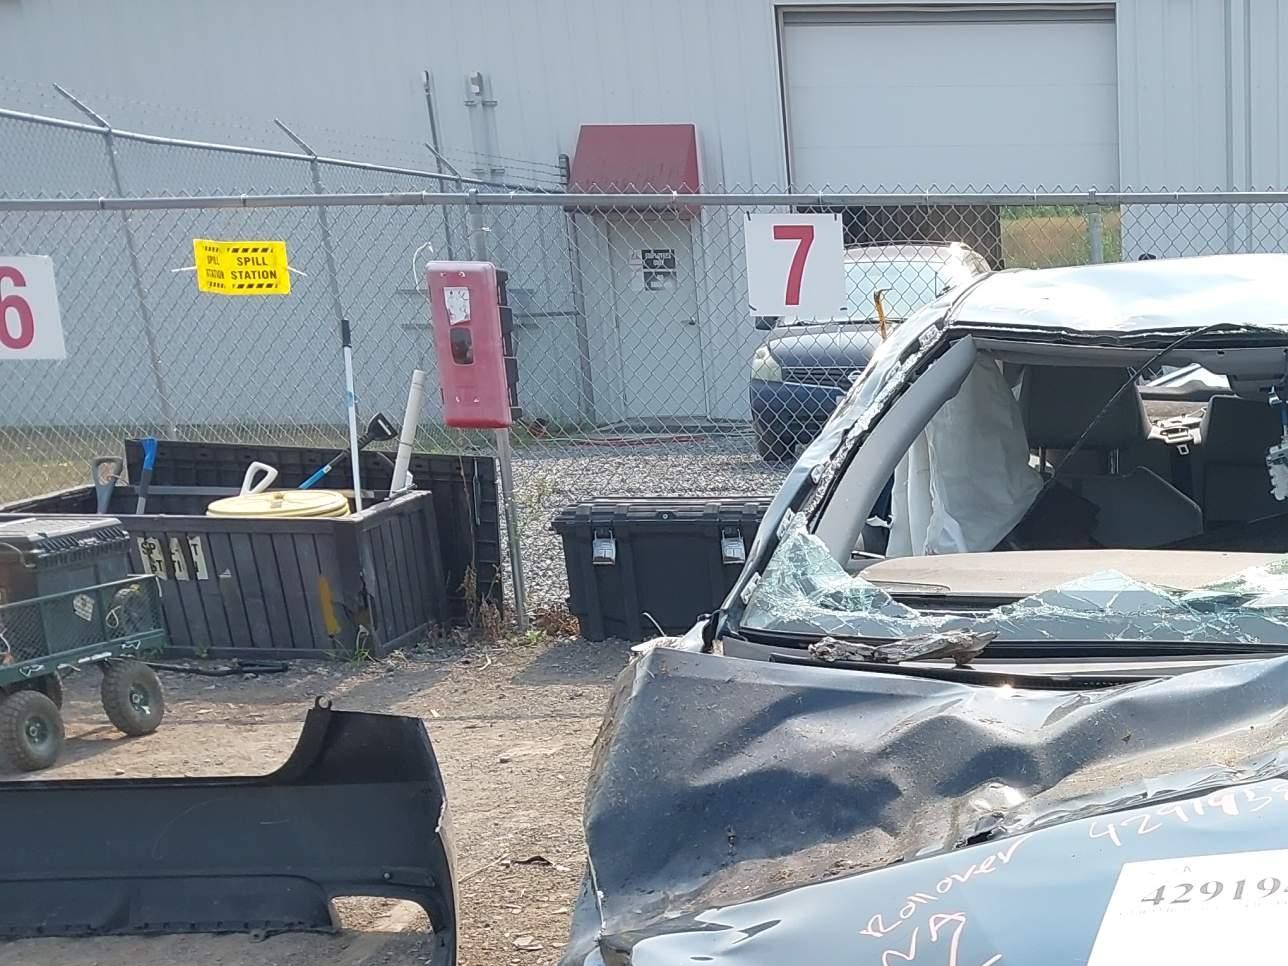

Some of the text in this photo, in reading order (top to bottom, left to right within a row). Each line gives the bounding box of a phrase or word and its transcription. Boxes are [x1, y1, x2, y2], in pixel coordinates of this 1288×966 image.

[230, 269, 277, 280] STATION
[236, 256, 268, 266] SPILL
[773, 225, 815, 306] 7
[0, 266, 34, 350] 6
